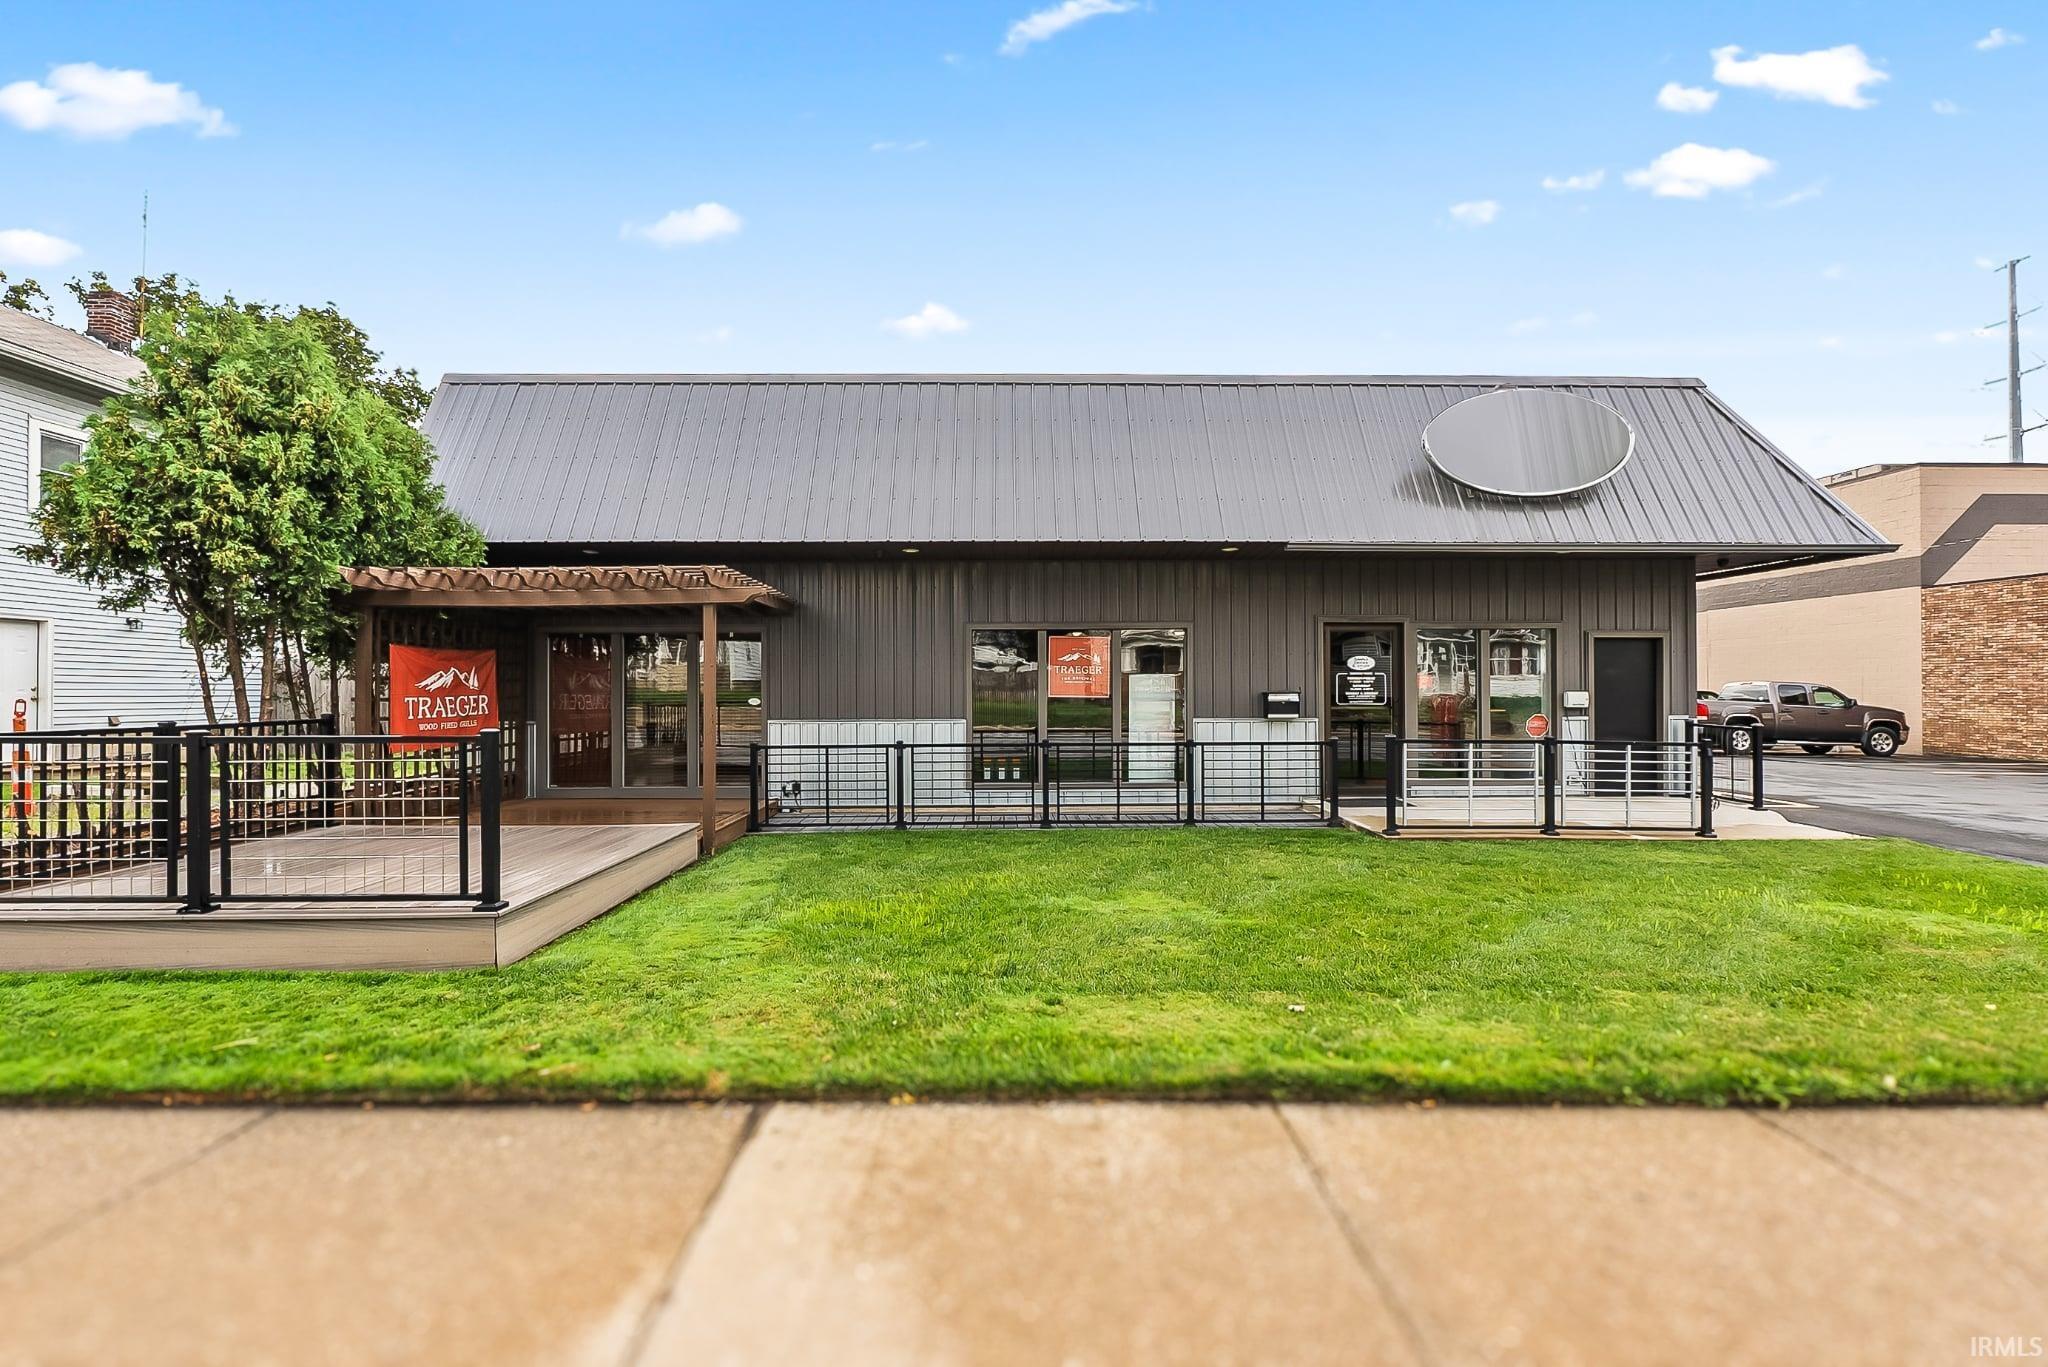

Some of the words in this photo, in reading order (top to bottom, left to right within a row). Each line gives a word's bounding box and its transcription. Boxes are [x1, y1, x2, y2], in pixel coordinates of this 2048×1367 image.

[1054, 665, 1103, 675] TRAEGER
[404, 694, 489, 720] TRAEGER
[418, 722, 438, 731] WOOD
